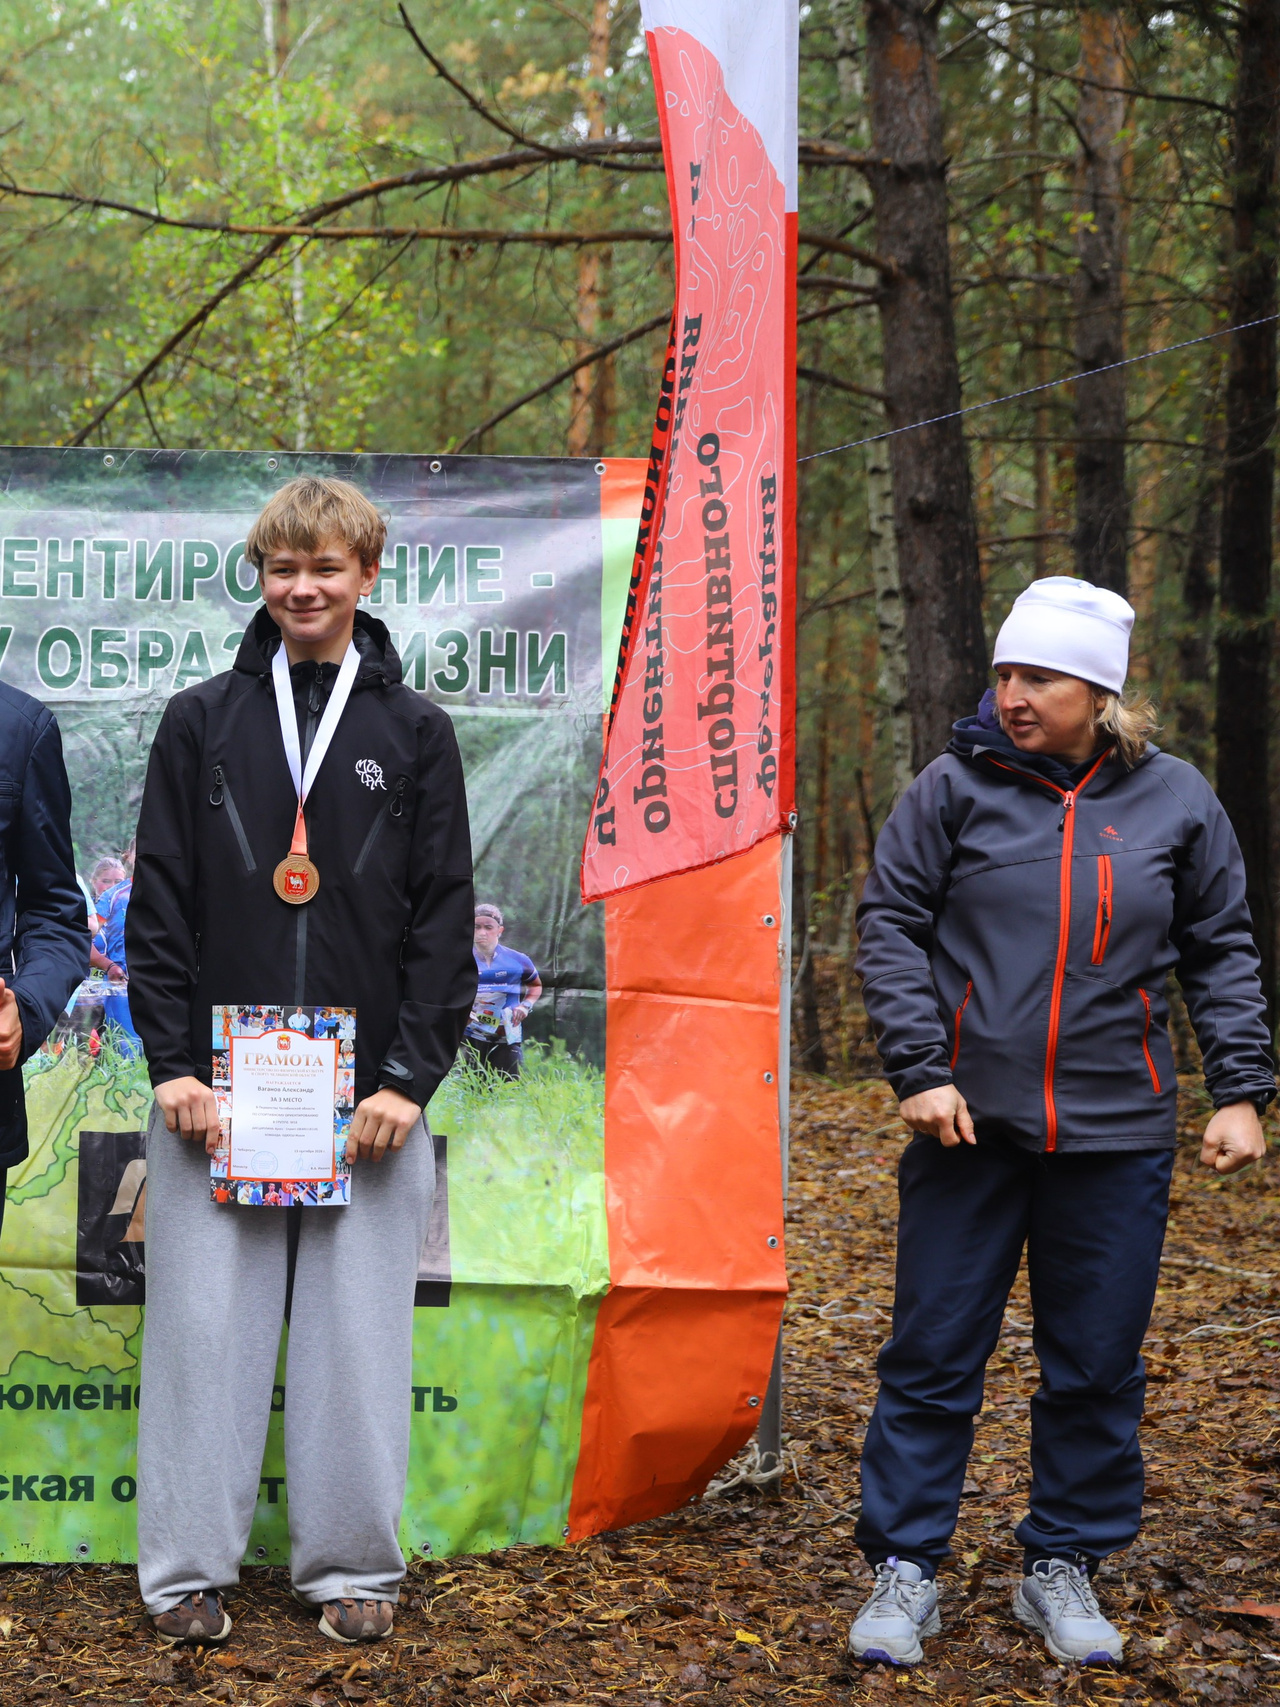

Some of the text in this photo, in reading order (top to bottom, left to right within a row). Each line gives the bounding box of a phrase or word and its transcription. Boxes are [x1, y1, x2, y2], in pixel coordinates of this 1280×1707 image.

[35, 625, 246, 691] ОБРА
[388, 628, 568, 696] ИЗНИ
[244, 1052, 324, 1067] ГРАМОТА
